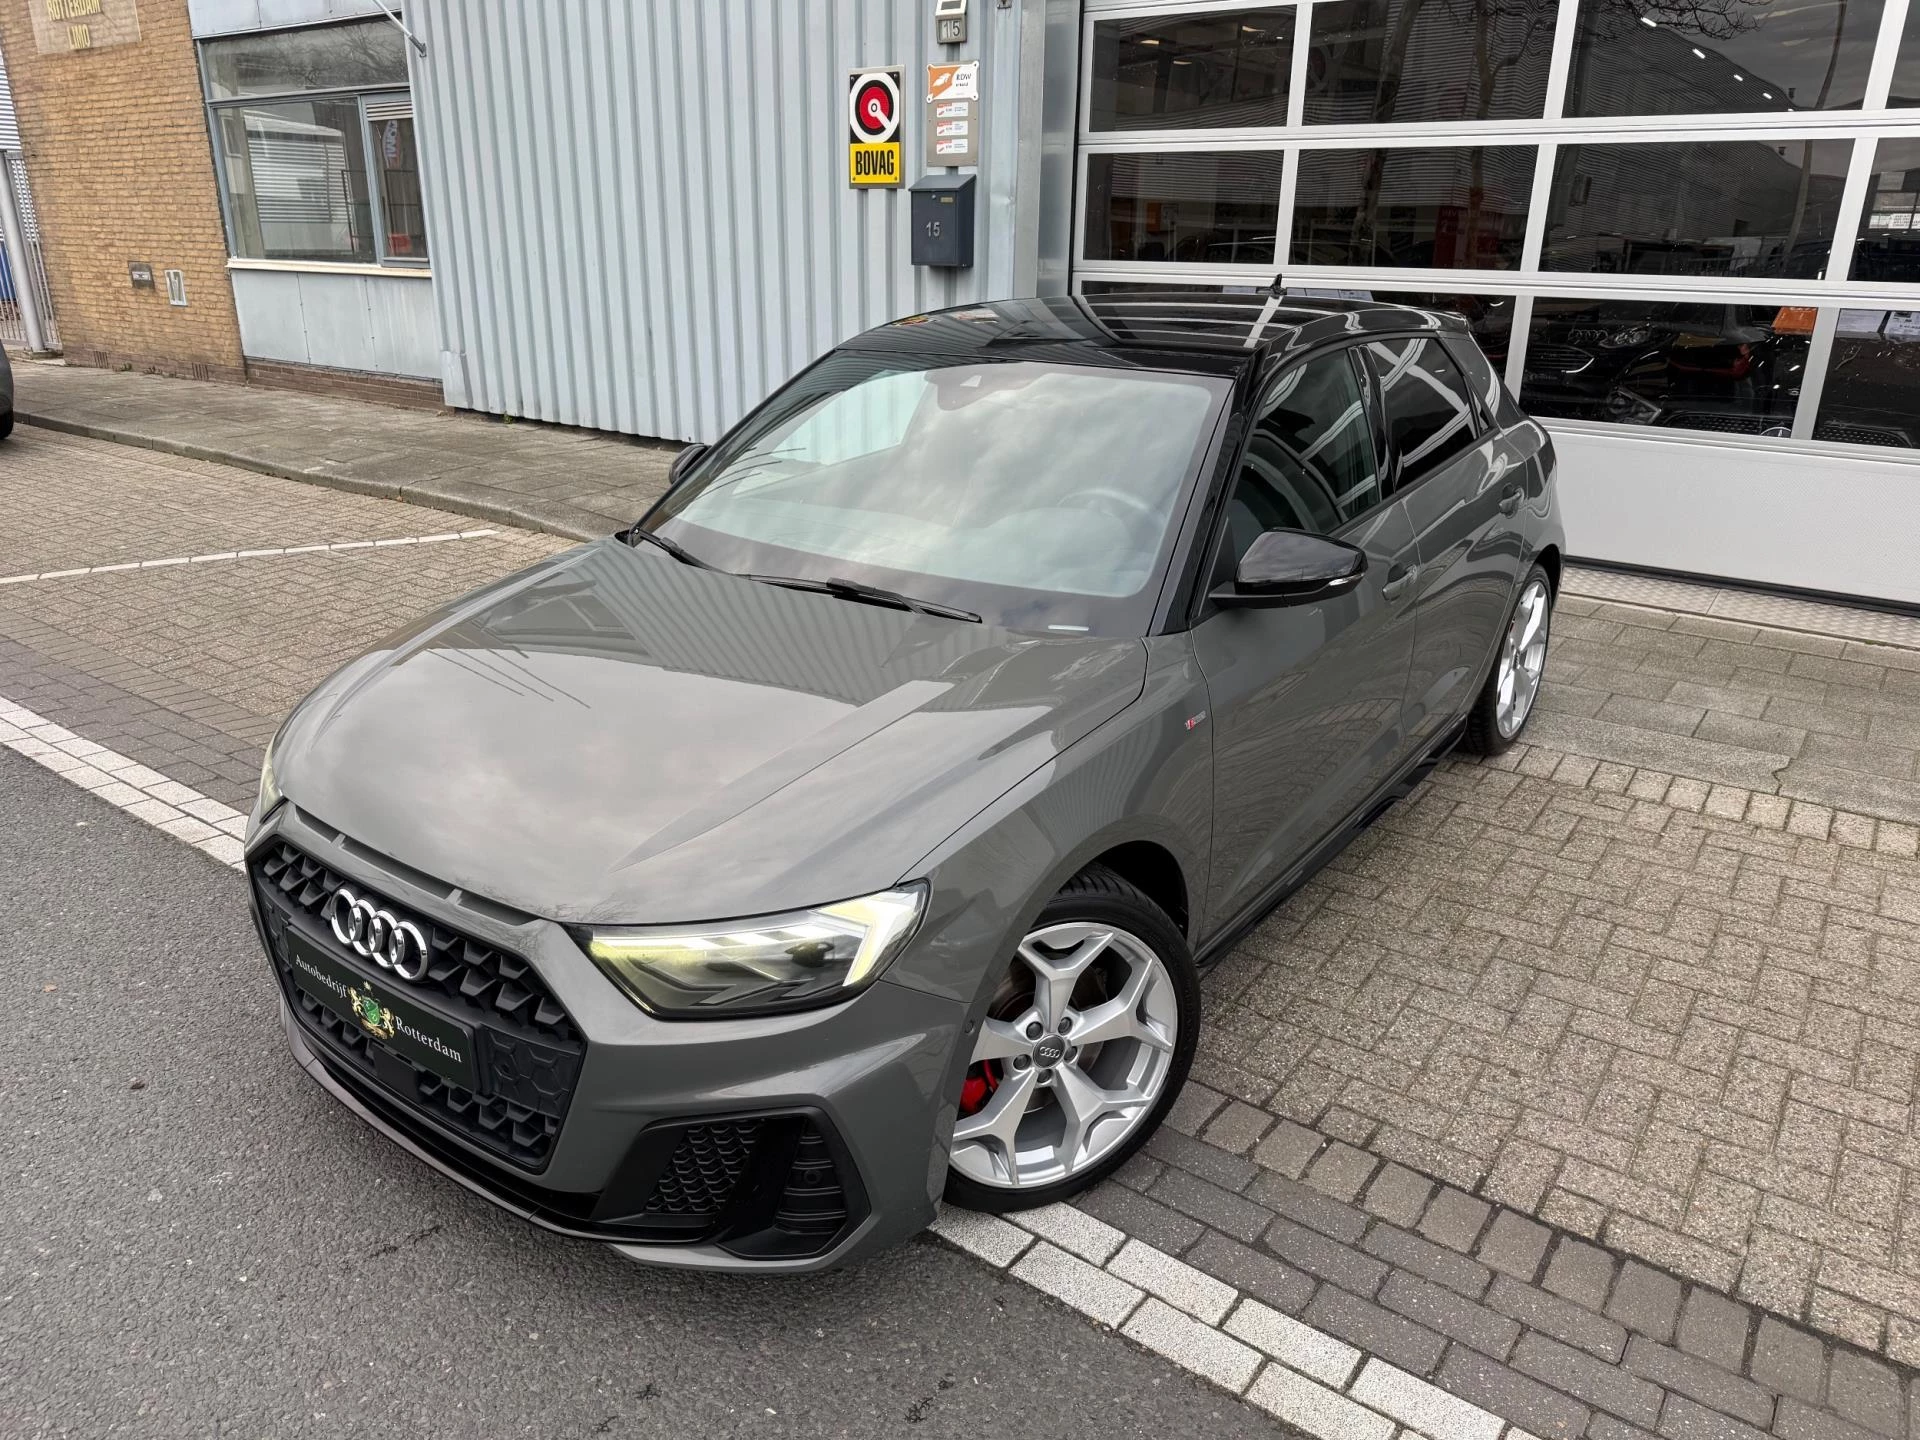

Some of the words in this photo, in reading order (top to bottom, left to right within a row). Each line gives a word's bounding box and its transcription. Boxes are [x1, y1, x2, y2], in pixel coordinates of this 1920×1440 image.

[46, 0, 101, 20] ROTTERDAM
[67, 24, 90, 49] LIMO
[943, 20, 960, 38] 15
[855, 150, 894, 176] BOVAG
[926, 221, 940, 237] 15
[295, 954, 348, 999] Autobedrijf
[395, 1015, 462, 1063] Rotterdam
